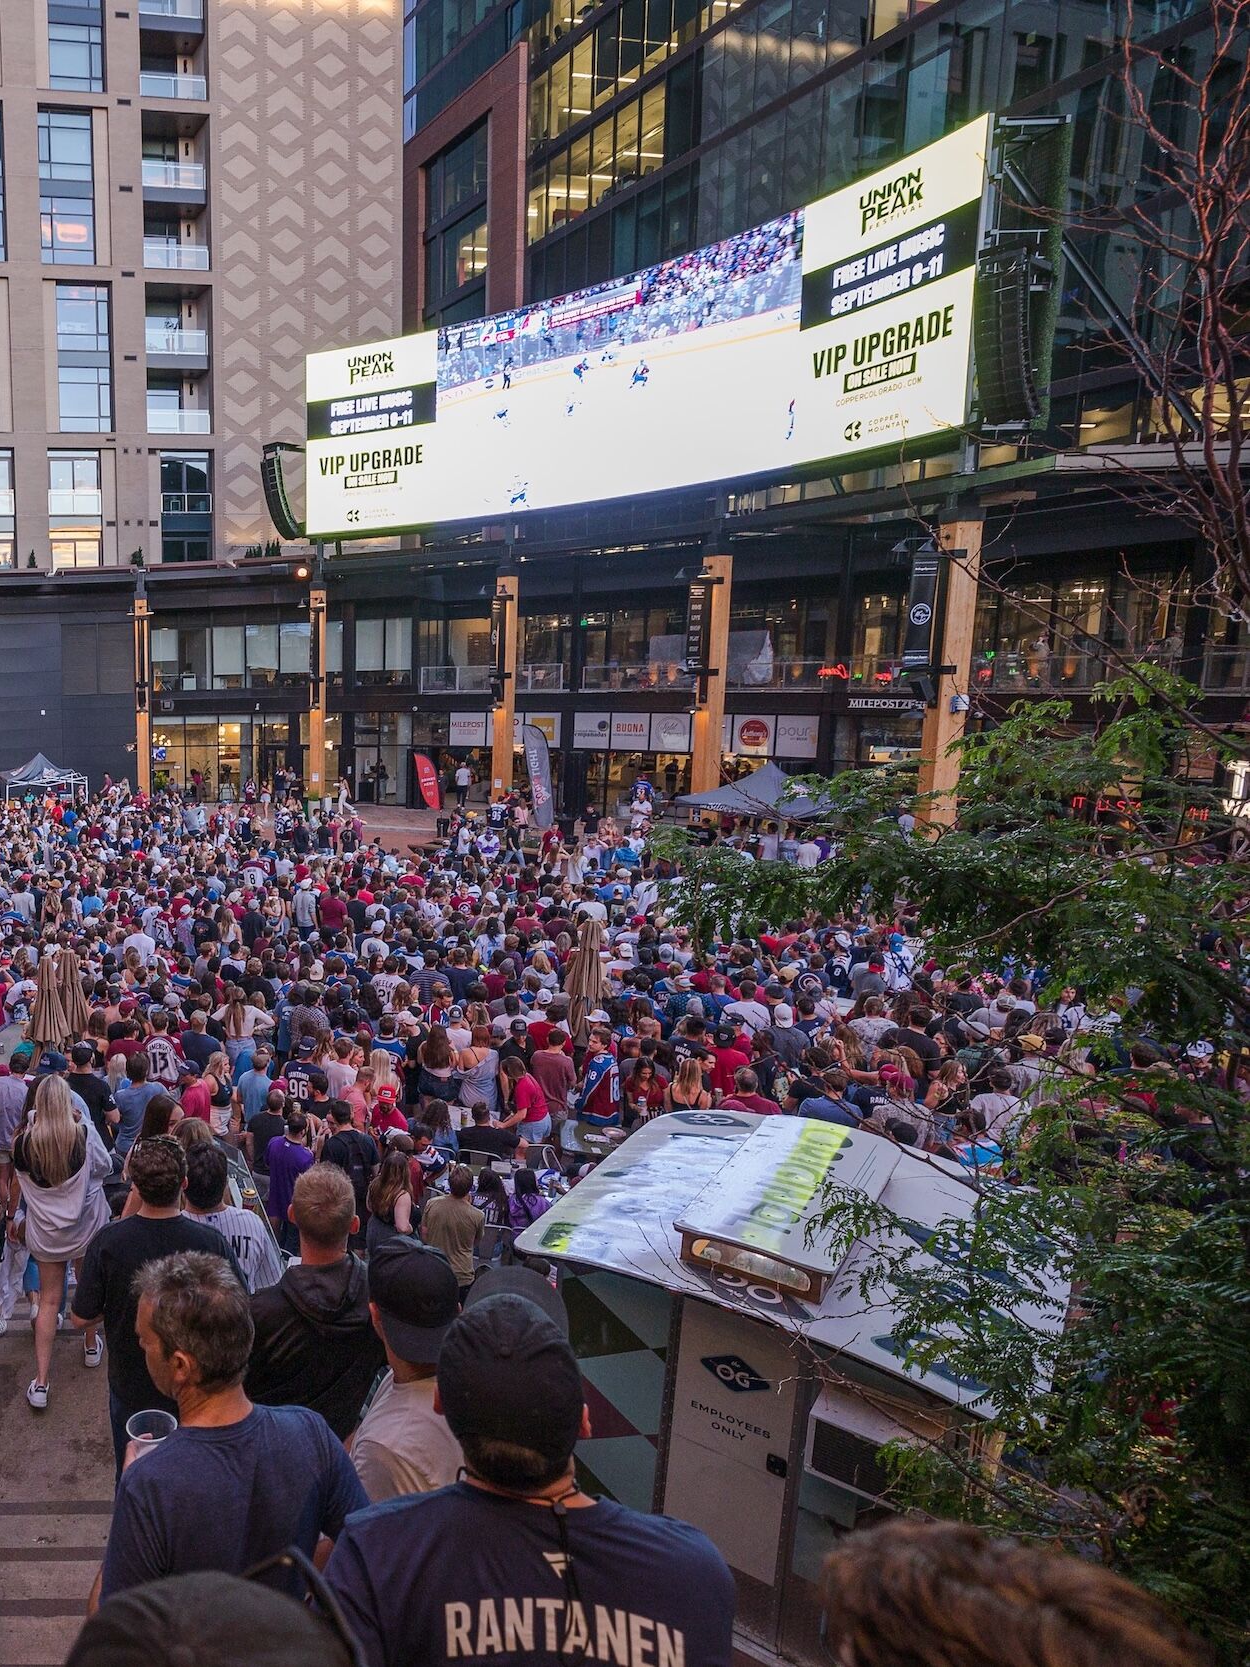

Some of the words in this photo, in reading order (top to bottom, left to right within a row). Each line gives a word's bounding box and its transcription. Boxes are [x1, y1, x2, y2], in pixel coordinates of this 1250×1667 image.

[859, 167, 922, 210] UNION
[861, 182, 924, 236] PEAK
[868, 203, 924, 231] FESTIVAL
[832, 257, 867, 289] FREE
[867, 243, 899, 277] LIVE
[898, 223, 945, 263] MUSIC
[830, 267, 912, 316] SEPTEMBER
[812, 343, 847, 379] VIP
[852, 304, 955, 367] UPGRADE
[347, 351, 393, 369] UNION
[350, 361, 395, 386] PEAK
[847, 371, 863, 390] ON
[862, 362, 890, 386] SALE
[889, 354, 914, 378] NOW
[835, 375, 923, 408] COPPERCOLORADO.COM
[355, 396, 379, 414] LIVE
[330, 413, 390, 435] SEPTEMBER
[867, 418, 910, 433] MOUNTAIN
[868, 413, 900, 426] COPPER
[319, 455, 345, 476] VIP
[350, 444, 423, 472] UPGRADE
[850, 699, 900, 709] MILEPOST
[616, 723, 644, 733] BUONA
[778, 726, 811, 737] pour
[250, 873, 256, 884] 8
[833, 967, 842, 976] 8
[151, 1052, 169, 1074] 13
[289, 1079, 309, 1100] 96
[716, 1363, 751, 1389] OG
[691, 1400, 771, 1440] EMPLOYEES
[711, 1421, 746, 1441] ONLY
[444, 1597, 686, 1667] RANTANEN
